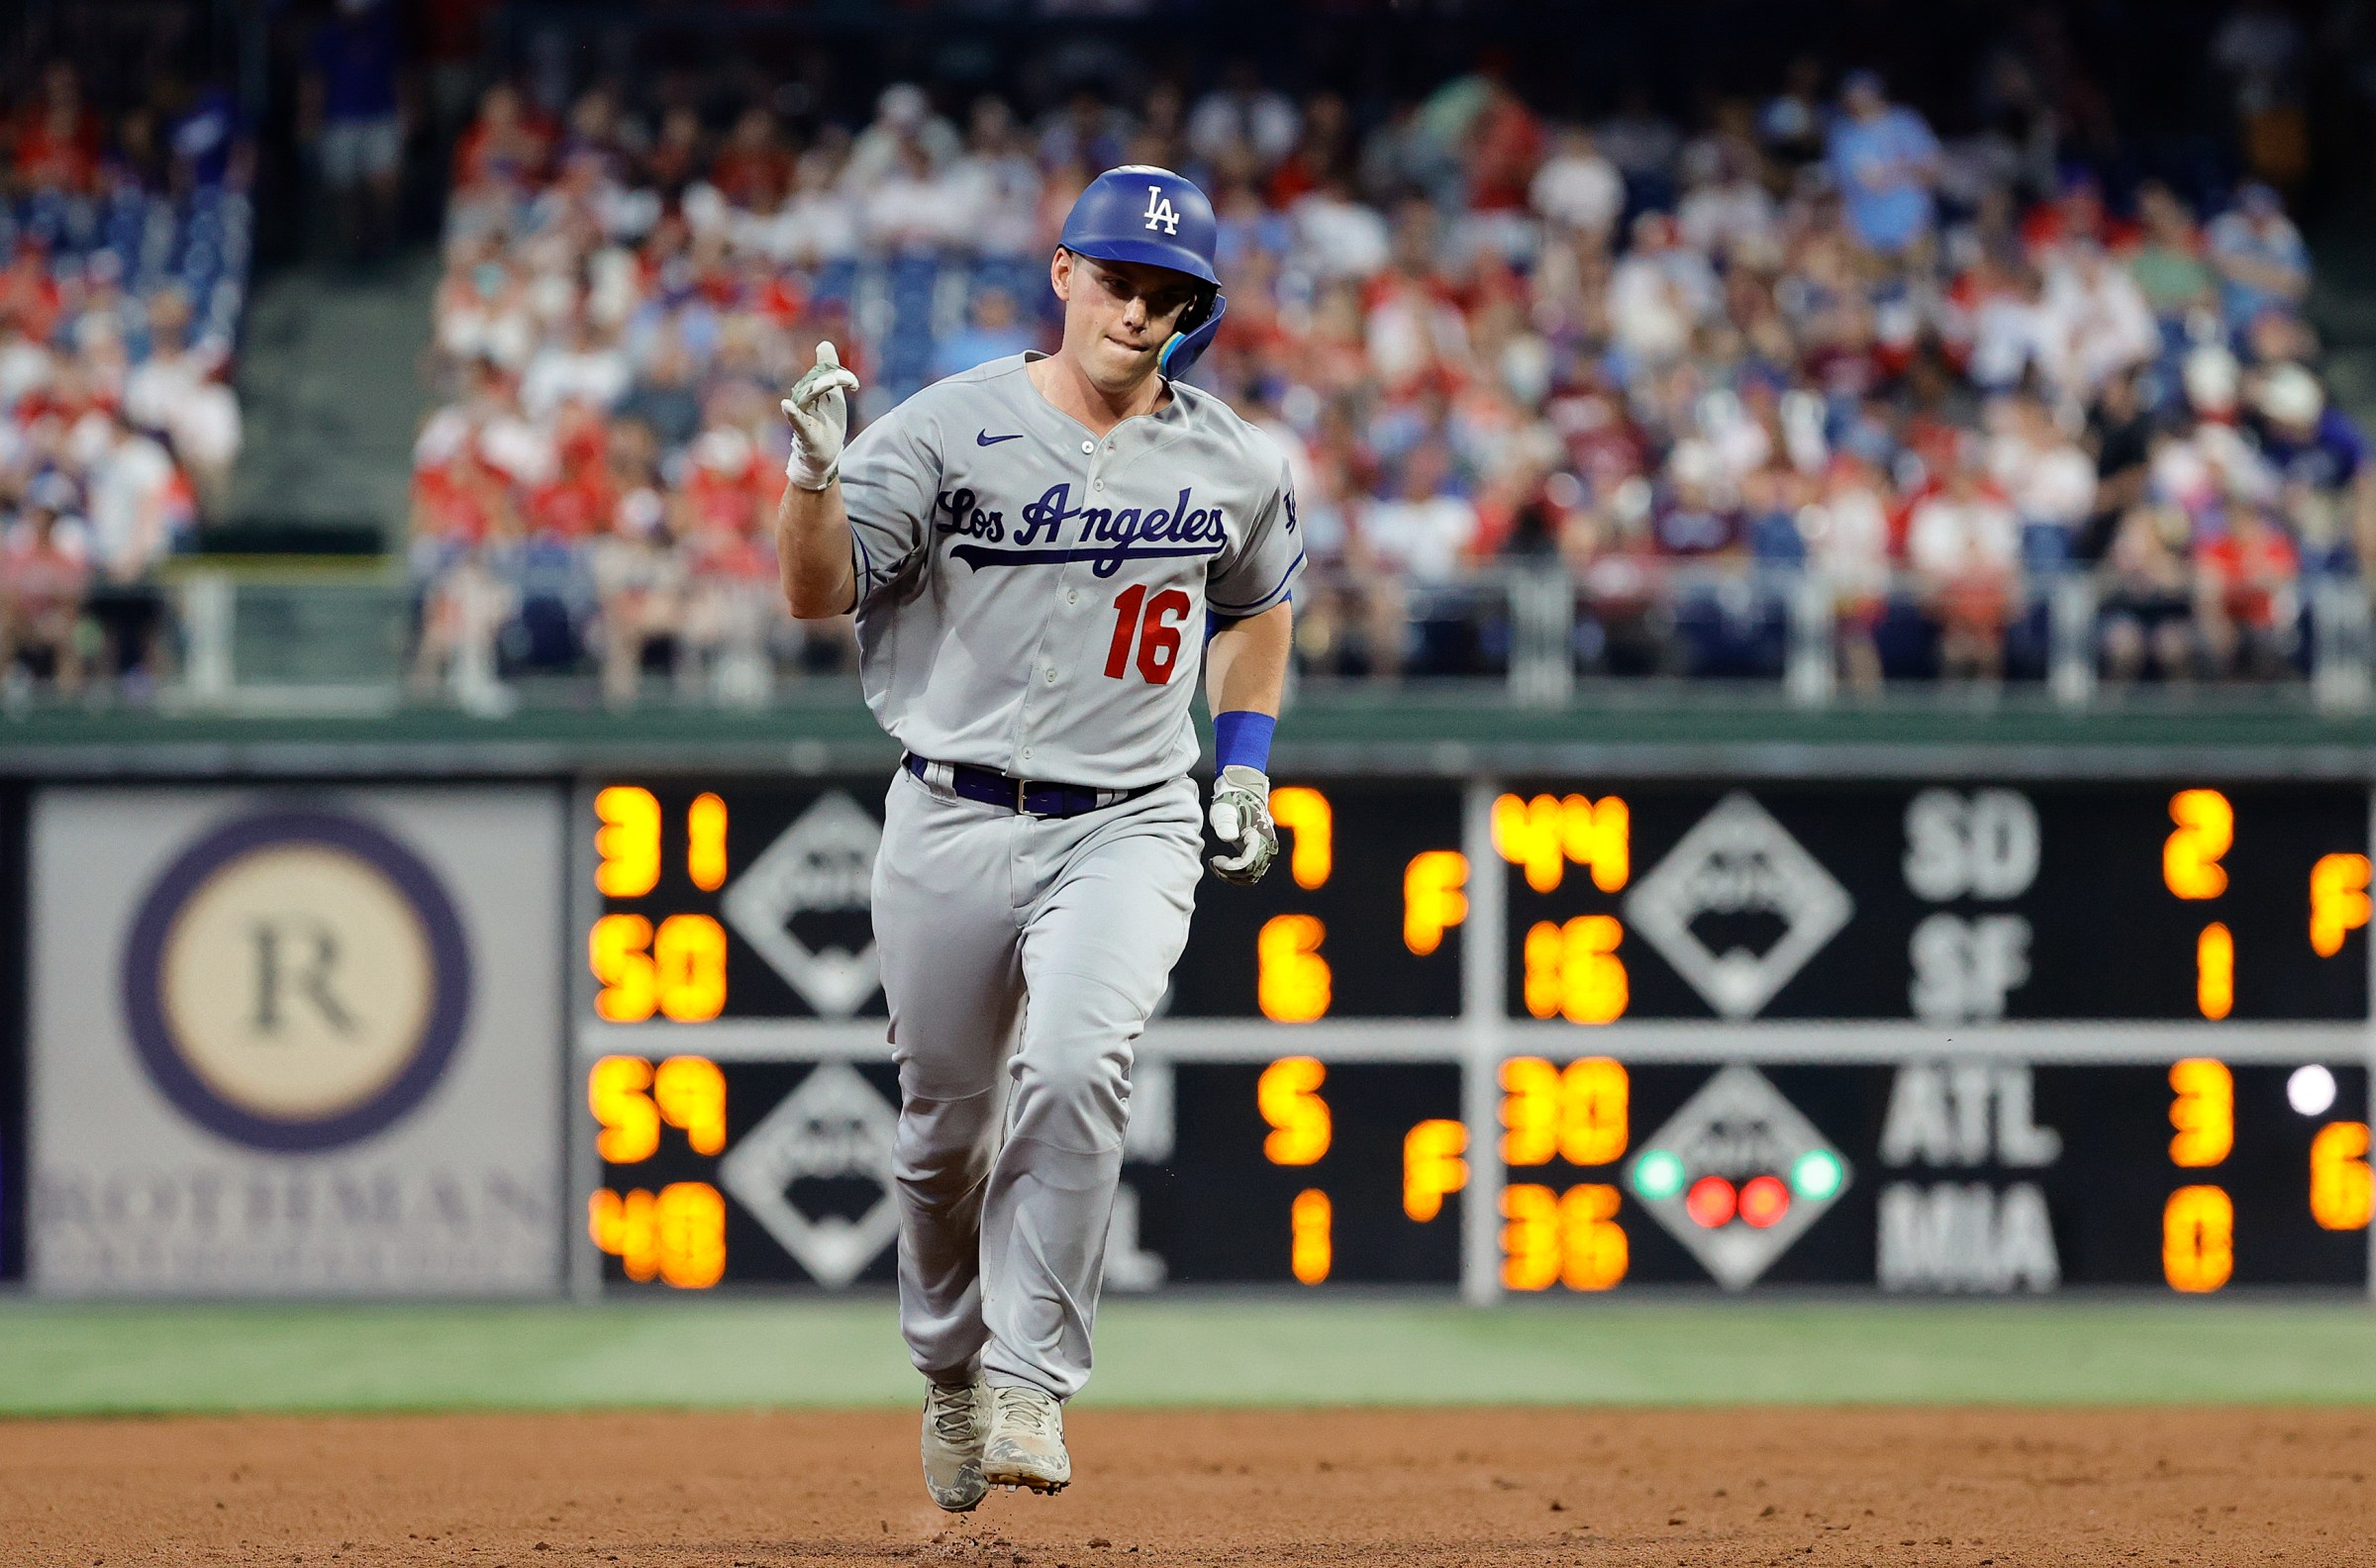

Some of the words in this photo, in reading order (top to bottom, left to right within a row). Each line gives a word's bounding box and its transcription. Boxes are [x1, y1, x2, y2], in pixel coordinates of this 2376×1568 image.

[1144, 185, 1179, 236] LA
[936, 486, 1005, 543] Los
[1014, 482, 1228, 578] Angeles
[1104, 583, 1191, 685] 16
[594, 786, 729, 898] 31
[1268, 787, 1333, 890] 7
[1493, 794, 1630, 894] 44
[1901, 787, 2041, 902] SD
[2163, 789, 2234, 899] 2
[1404, 850, 1469, 956] F
[2310, 853, 2373, 958] F
[248, 921, 364, 1039] R
[590, 914, 728, 1023] 50
[1258, 915, 1333, 1024] 6
[1525, 916, 1630, 1025] 16
[1909, 913, 2032, 1028] SF
[2197, 922, 2234, 1022] 1
[590, 1055, 728, 1164] 59
[1257, 1057, 1333, 1166] 5
[1501, 1057, 1630, 1166] 30
[1881, 1059, 2062, 1167] ATL
[2168, 1058, 2234, 1168] 3
[1404, 1119, 1468, 1223] F
[2310, 1122, 2376, 1230] 6
[1292, 1188, 1333, 1286] 1
[1501, 1184, 1630, 1292] 36
[1877, 1183, 2061, 1292] MIA
[2162, 1184, 2234, 1293] 0
